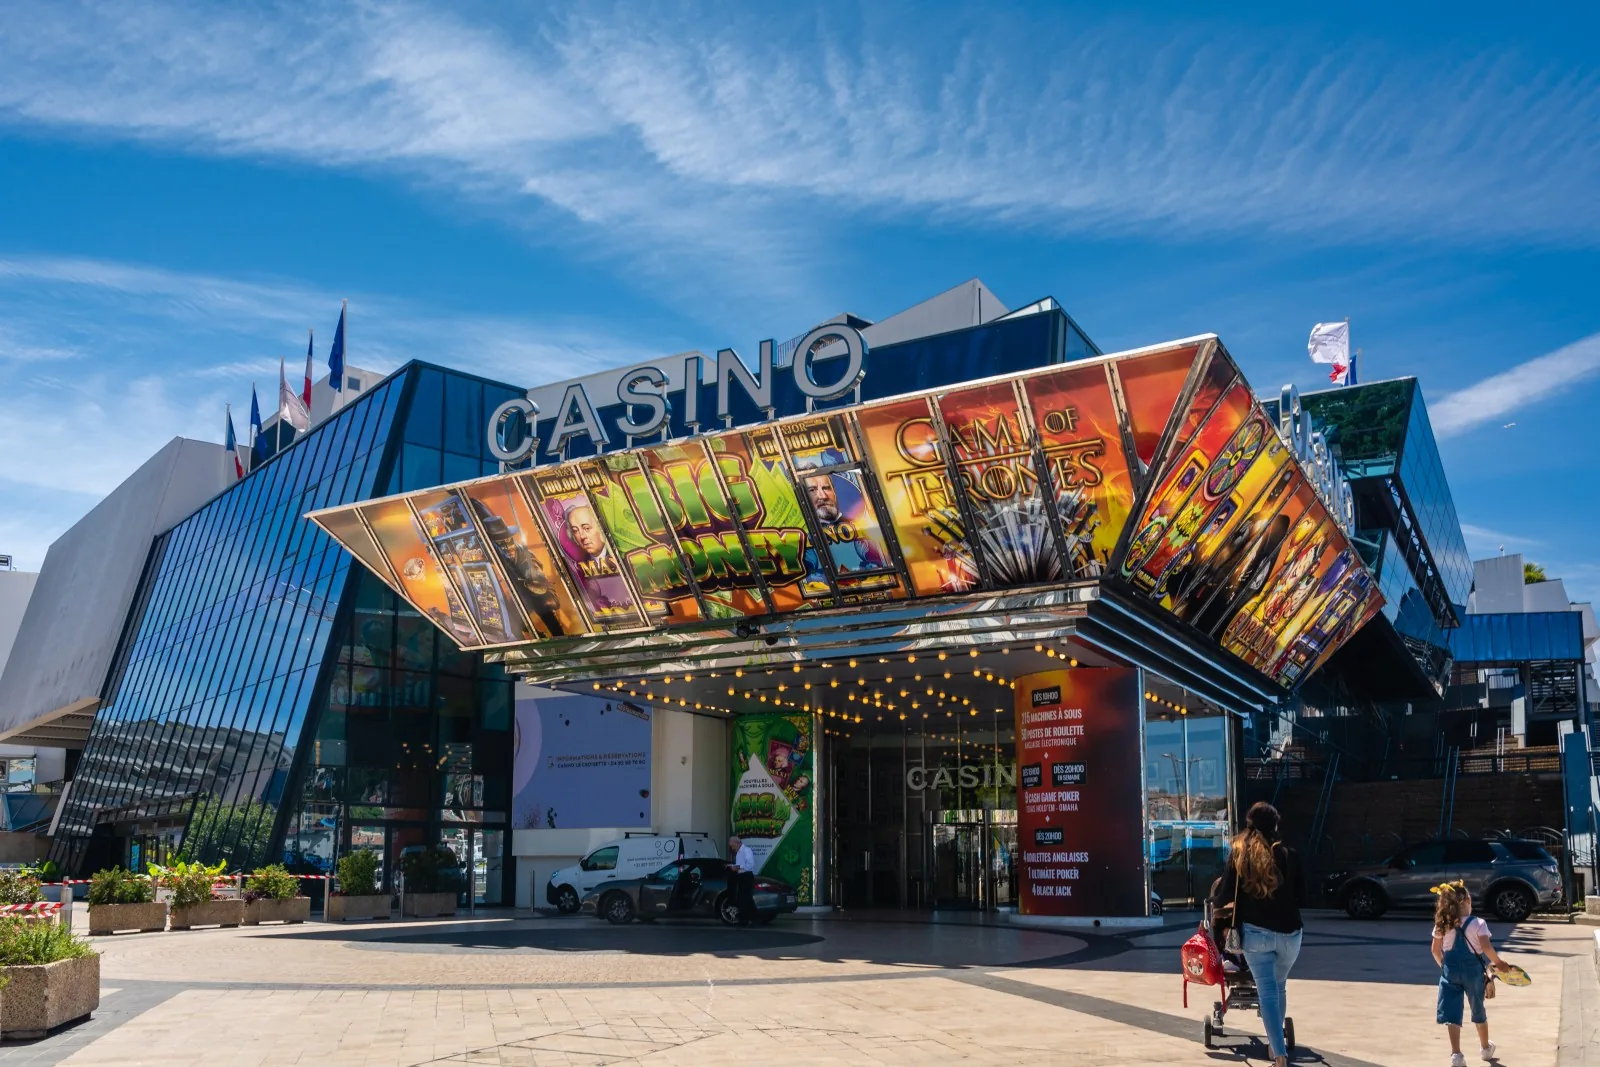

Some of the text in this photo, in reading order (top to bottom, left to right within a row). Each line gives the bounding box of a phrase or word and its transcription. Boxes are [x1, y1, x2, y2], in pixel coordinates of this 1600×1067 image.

[487, 322, 869, 464] CASINO
[1044, 406, 1080, 434] OF
[886, 446, 1108, 517] THRONES
[623, 457, 761, 534] BIG
[630, 532, 803, 594] MONEY
[1031, 710, 1057, 723] MACHINES
[1058, 707, 1063, 720] À
[1064, 708, 1082, 720] SOUS
[1027, 727, 1043, 739] POSTES
[1044, 727, 1053, 738] DE
[1053, 725, 1084, 737] ROULETTE
[1042, 738, 1077, 748] ÉLECTRONIQUE
[1054, 764, 1085, 774] DÈS 20H00
[907, 763, 1017, 790] CASIN
[1029, 793, 1040, 804] CASH
[1041, 791, 1057, 803] GAME
[1058, 790, 1080, 802] POKER
[1059, 803, 1079, 812] OMAHA
[1027, 852, 1051, 863] ROULETTES
[1052, 852, 1089, 863] ANGLAISES
[1031, 868, 1055, 880] ULTIMATE
[1056, 868, 1079, 880] POKER
[1036, 886, 1054, 896] BLACK
[1055, 885, 1072, 897] JACK
